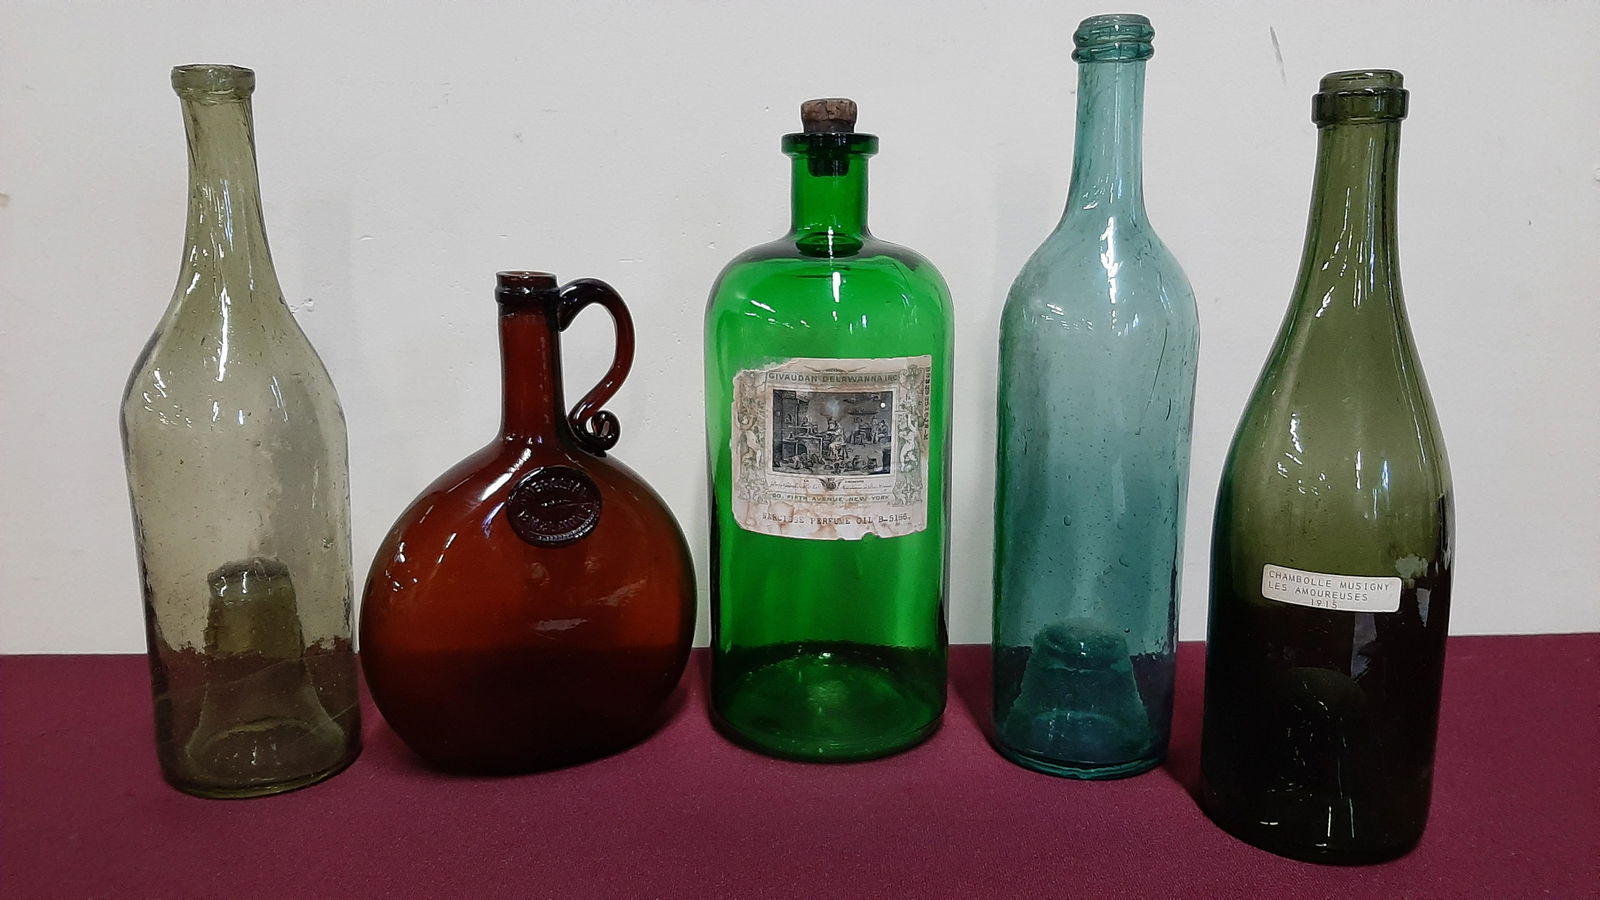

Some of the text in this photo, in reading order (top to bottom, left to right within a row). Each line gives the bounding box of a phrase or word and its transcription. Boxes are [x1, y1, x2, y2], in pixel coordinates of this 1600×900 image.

[768, 372, 818, 382] GIVAUDAN
[810, 517, 851, 525] PERFUME
[856, 516, 873, 525] OIL
[1268, 570, 1390, 592] CHAMBOLLE MUSIGNY
[1268, 580, 1369, 602] LES AMOUREUSES
[1311, 598, 1338, 609] 1915
